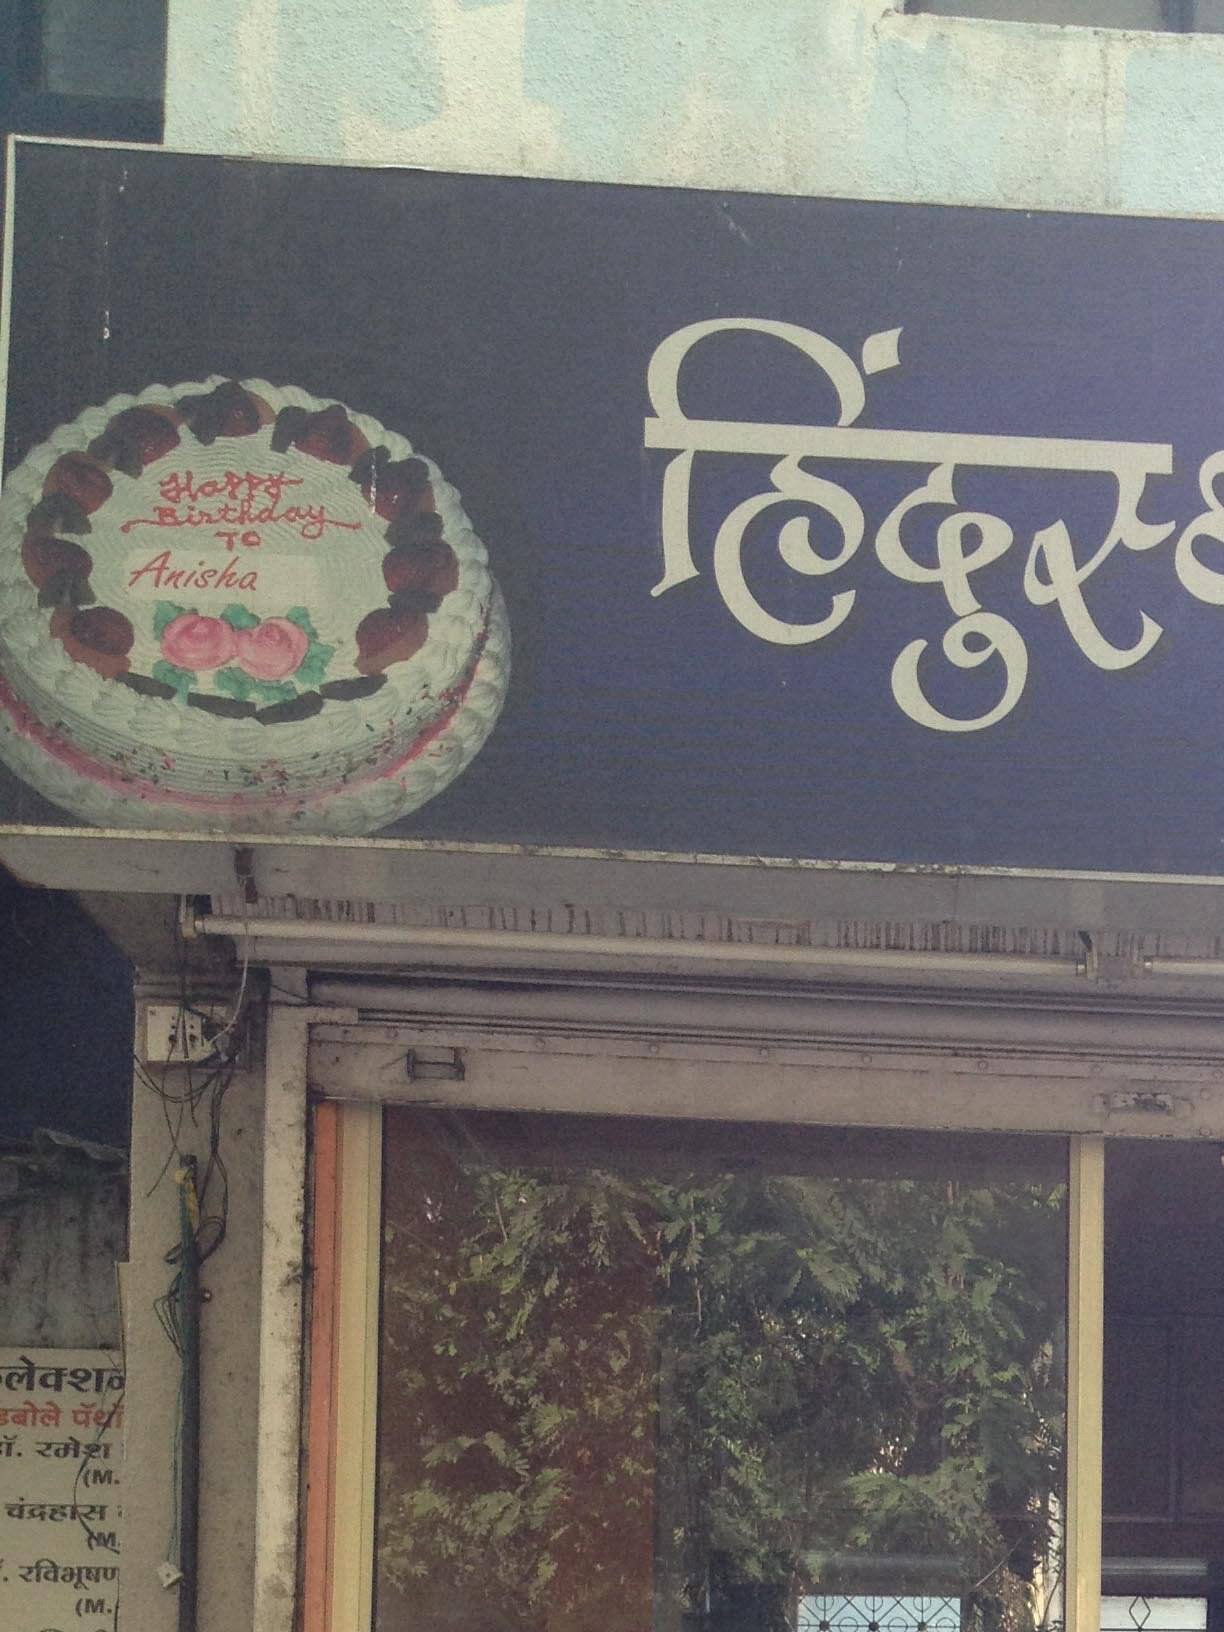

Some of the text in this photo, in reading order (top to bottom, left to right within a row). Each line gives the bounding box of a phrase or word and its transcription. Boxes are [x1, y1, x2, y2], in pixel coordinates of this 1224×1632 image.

[158, 470, 304, 507] Happy
[121, 499, 363, 539] Birthday
[128, 550, 258, 591] Anisha
